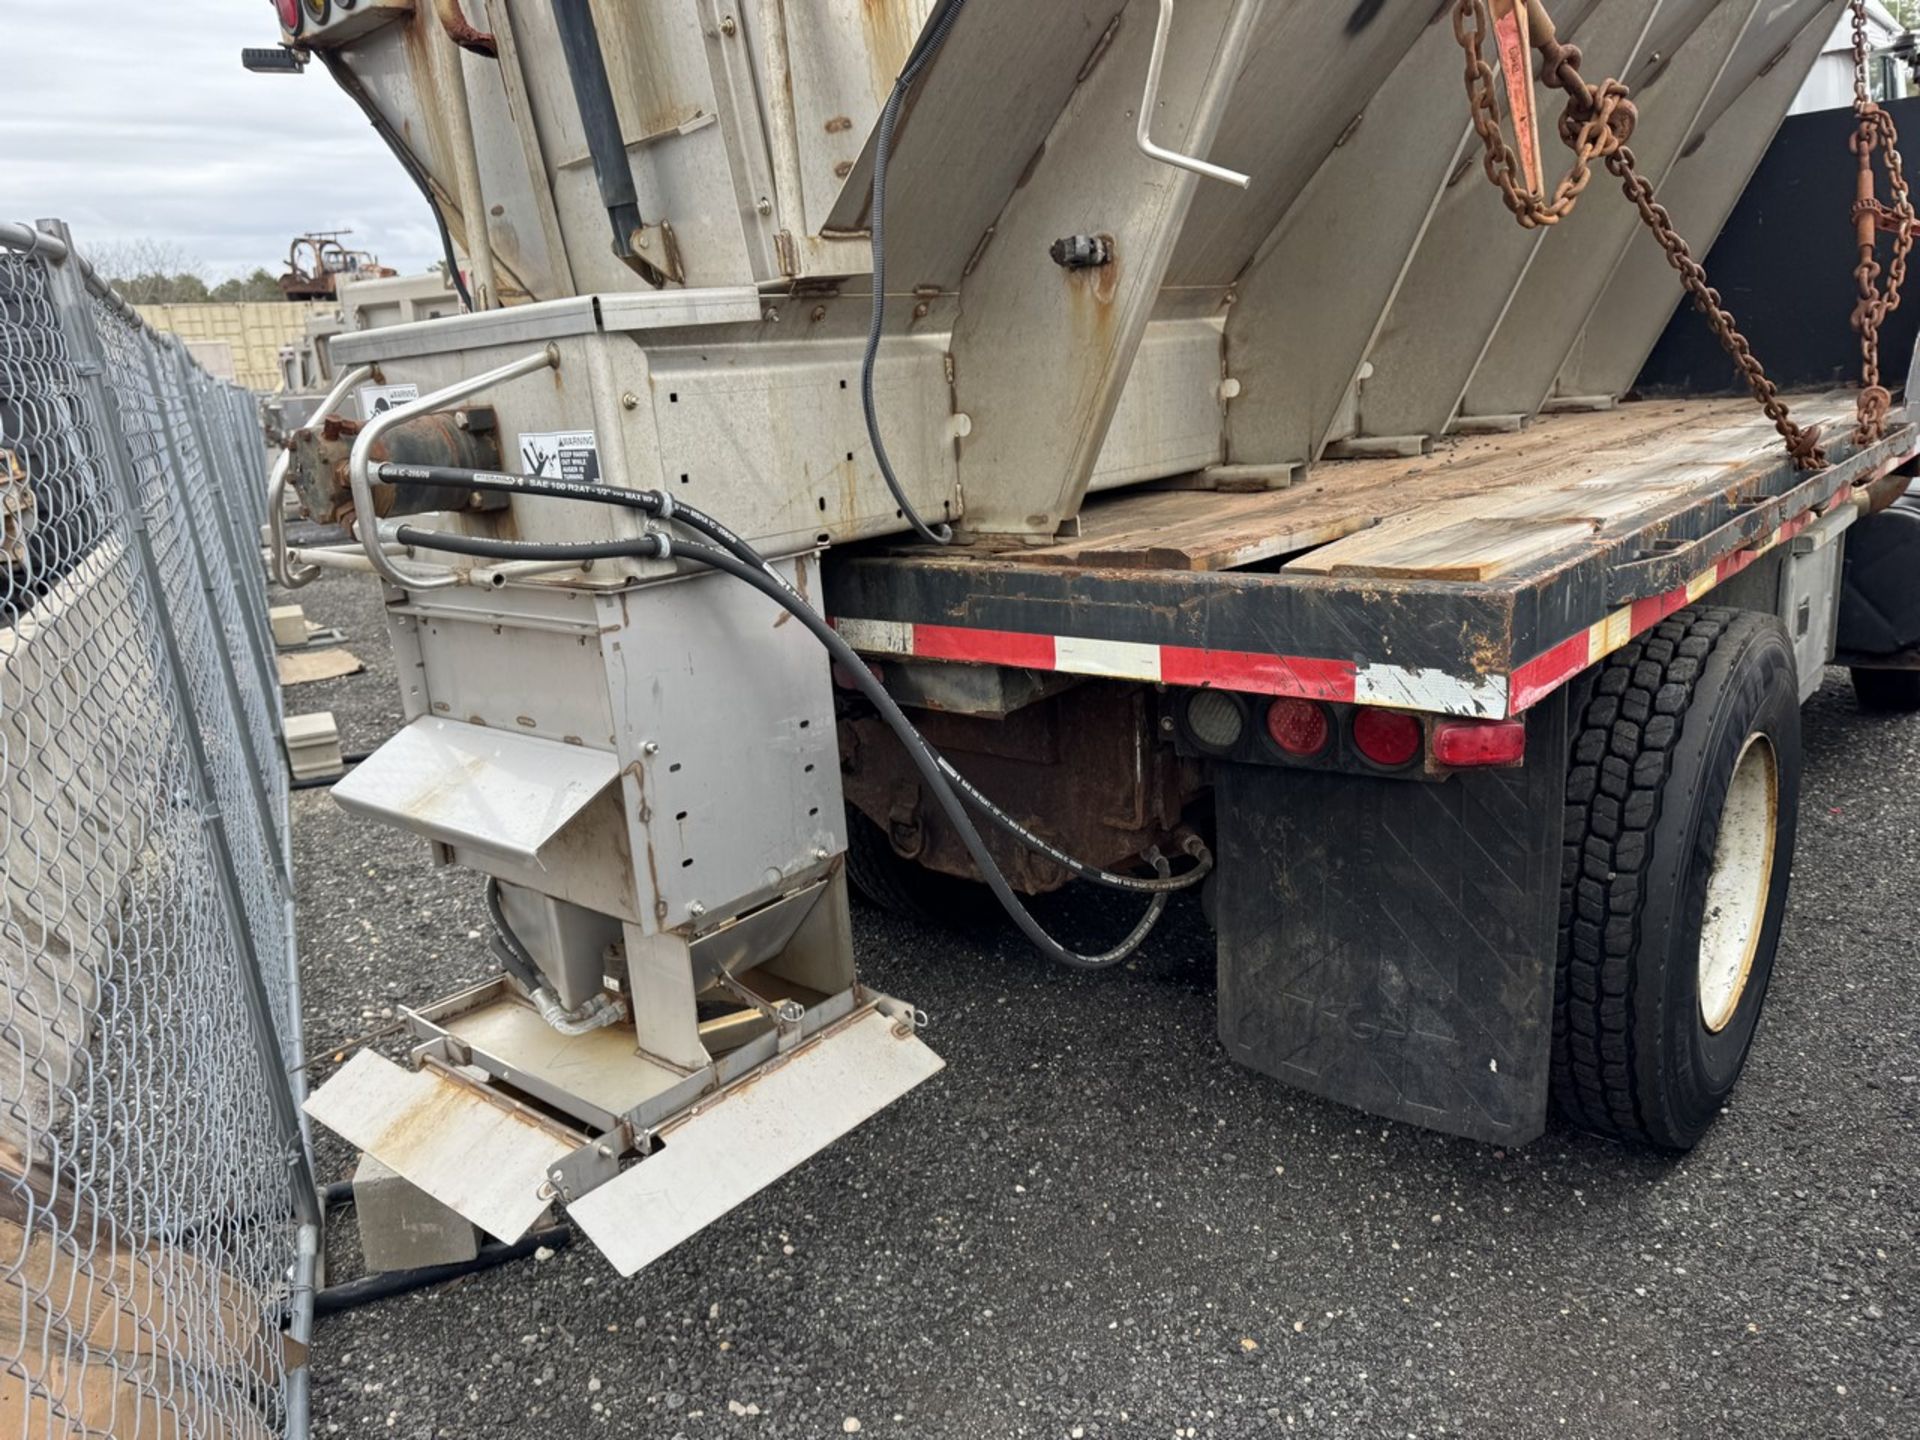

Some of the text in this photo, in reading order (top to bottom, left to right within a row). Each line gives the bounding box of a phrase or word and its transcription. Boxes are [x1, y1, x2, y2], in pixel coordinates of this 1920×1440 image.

[563, 435, 594, 447] WARNING
[529, 479, 549, 489] SAE
[551, 482, 566, 491] 100
